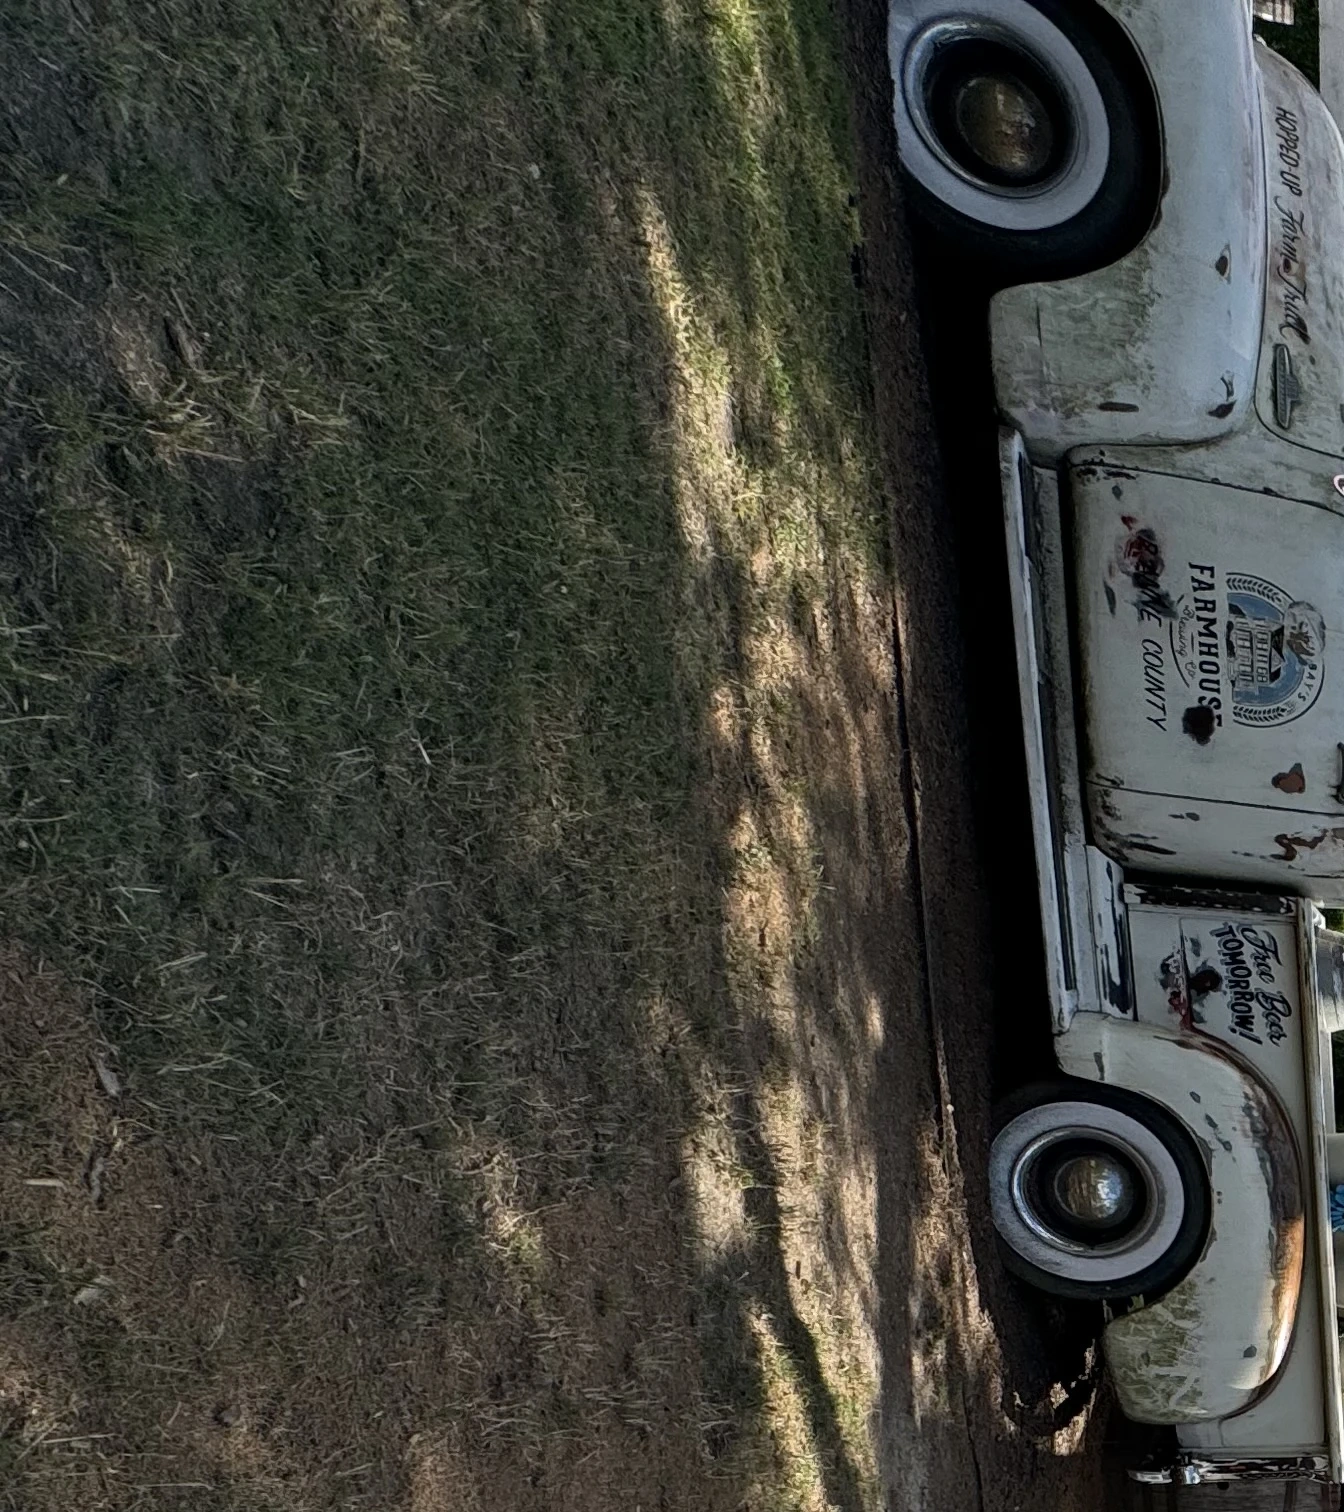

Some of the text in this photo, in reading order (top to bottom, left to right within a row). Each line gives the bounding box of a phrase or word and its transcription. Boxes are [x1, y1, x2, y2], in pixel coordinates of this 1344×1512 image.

[1275, 106, 1303, 196] HOPPED-UP
[1274, 196, 1305, 263] Farm
[1141, 638, 1167, 732] COUNTY
[1188, 561, 1223, 728] FARMHOUS
[1297, 663, 1318, 702] BAY'S
[1212, 924, 1263, 1045] TOMORROW!
[1239, 926, 1293, 1048] Free Beer
